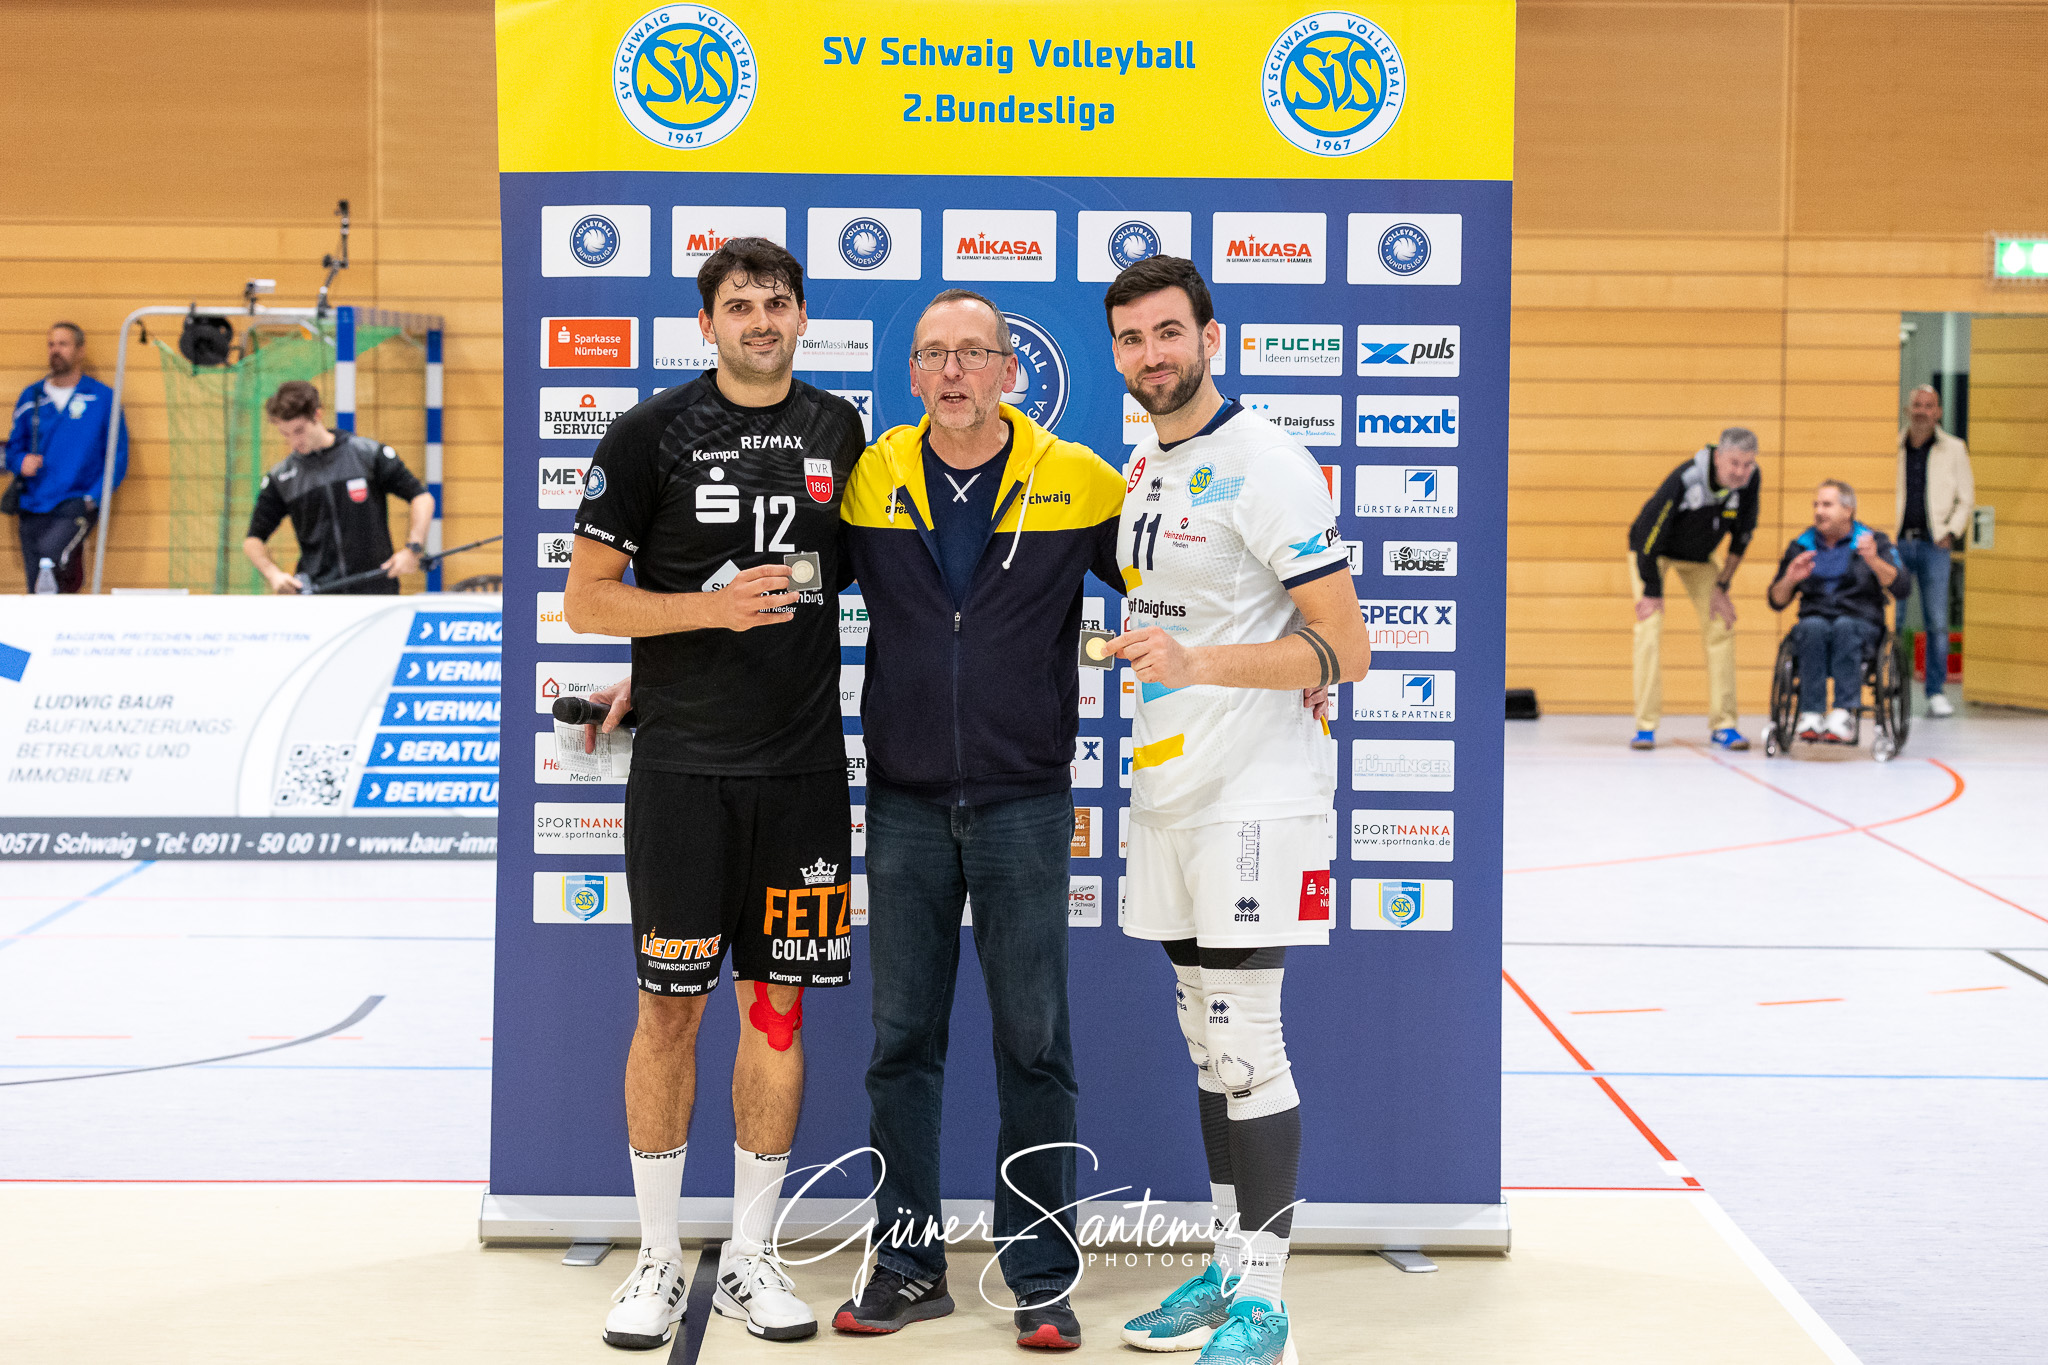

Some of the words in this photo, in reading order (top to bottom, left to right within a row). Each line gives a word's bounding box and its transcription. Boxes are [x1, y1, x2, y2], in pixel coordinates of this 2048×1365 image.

[619, 13, 671, 73] SCHWAIG
[1267, 20, 1320, 81] SCHWAIG
[697, 11, 752, 100] VOLLEYBALL
[823, 36, 867, 65] SV
[881, 37, 1013, 73] Schwaig
[1028, 39, 1196, 75] Volleyball
[1347, 19, 1399, 107] VOLLEYBALL
[619, 81, 633, 99] SV
[1267, 88, 1281, 107] SV
[903, 93, 1115, 131] 2.Bundesliga
[667, 131, 703, 144] 1967
[1316, 139, 1351, 151] 1967
[575, 221, 615, 239] VOLLEYBALL
[845, 223, 885, 241] VOLLEYBALL
[1115, 227, 1154, 244] VOLLEYBALL
[1384, 229, 1424, 247] VOLLEYBALL
[576, 246, 614, 262] BUNDESLIGA
[846, 249, 885, 266] BUNDESLIGA
[1385, 254, 1424, 271] BUNDESLIGA
[575, 334, 621, 346] Sparkasse
[802, 339, 869, 349] DörrMassivHaus
[1266, 338, 1340, 351] FUCHS
[575, 347, 619, 358] Nürnberg
[1265, 354, 1291, 363] Ideen
[1294, 355, 1340, 364] umsetzen
[1410, 338, 1456, 364] puls
[656, 357, 690, 367] FÜRST
[554, 424, 607, 435] SERVIC
[1284, 416, 1335, 428] Daigfuss
[1358, 409, 1456, 435] maxit
[740, 435, 804, 450] RE/MAX
[692, 449, 740, 462] Kempa
[808, 462, 829, 474] TVR
[809, 481, 831, 494] 1861
[1357, 503, 1391, 514] FÜRST
[1404, 505, 1454, 514] PARTNER
[752, 495, 795, 553] 12
[584, 523, 616, 543] Kempa
[1163, 530, 1207, 543] Heinzelmann
[1132, 512, 1162, 571] 11
[1394, 560, 1445, 572] HOUSE
[1138, 599, 1187, 618] Daigfuss
[1360, 605, 1429, 625] SPECK
[438, 620, 502, 642] VERK
[839, 625, 869, 633] setzen
[1369, 629, 1430, 648] umpen
[33, 694, 113, 710] LUDWIG
[117, 694, 175, 710] BAUR
[1355, 708, 1388, 719] FÜRST
[1402, 710, 1452, 720] PARTNER
[16, 741, 142, 760] BETREUUNG
[145, 741, 192, 759] UND
[1354, 754, 1450, 773] HÜTTINGER
[7, 766, 134, 784] IMMOBILIEN
[569, 773, 602, 782] Medien
[384, 781, 499, 802] BEWERTU
[537, 817, 623, 828] SPORTNANK
[1353, 824, 1450, 836] SPORTNANKA
[537, 830, 625, 840] www.sportnanka.
[1354, 837, 1451, 847] www.sportnanka.de
[53, 831, 137, 859] Schwaig
[192, 832, 242, 854] 0911
[257, 832, 285, 854] 50
[286, 832, 315, 854] 00
[318, 832, 341, 854] 11
[358, 831, 497, 854] www.baur-imm
[1236, 820, 1256, 882] HÜTTIN
[763, 881, 851, 938] FETZ
[1234, 913, 1260, 922] errea
[772, 936, 851, 962] COLA-MIX
[648, 961, 711, 972] AUTOWASCHCENTER
[769, 971, 802, 983] Kempa
[812, 974, 843, 985] Kempa
[670, 983, 702, 995] Kempa
[1209, 1015, 1229, 1024] errea
[754, 1153, 790, 1162] Kem
